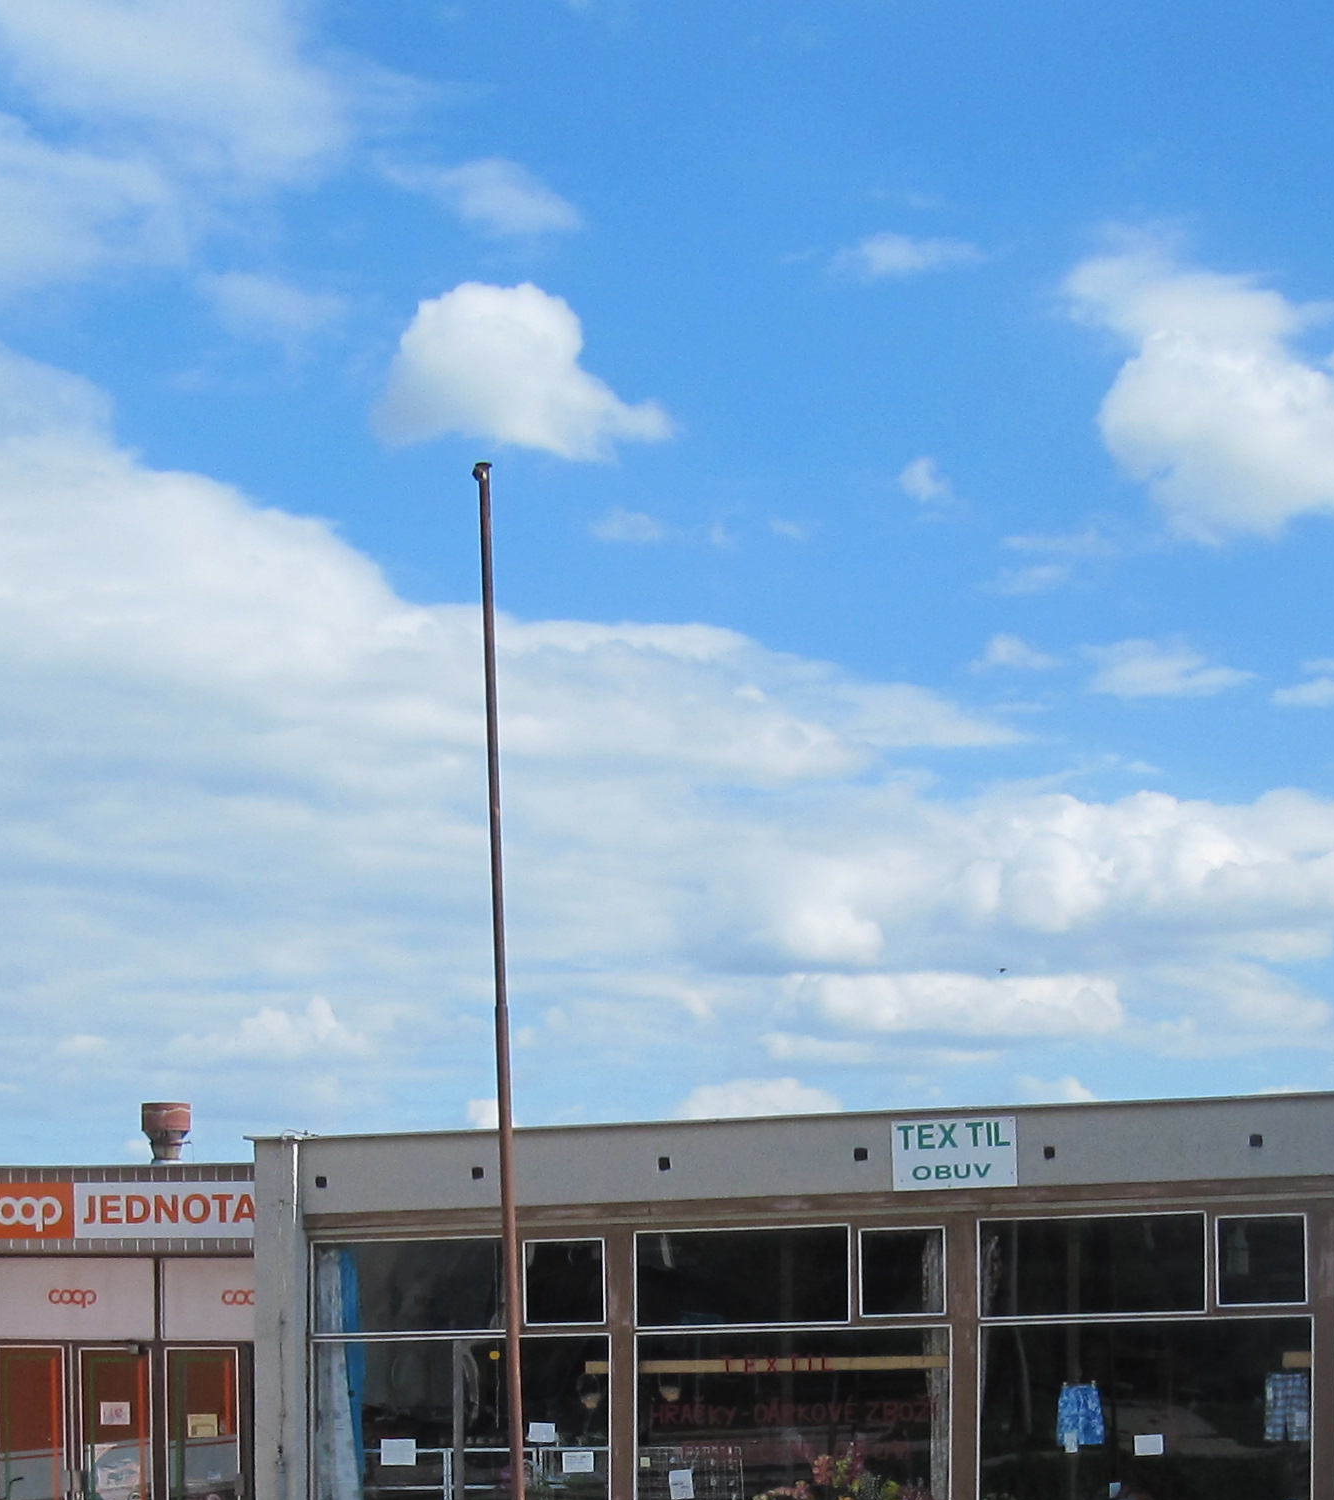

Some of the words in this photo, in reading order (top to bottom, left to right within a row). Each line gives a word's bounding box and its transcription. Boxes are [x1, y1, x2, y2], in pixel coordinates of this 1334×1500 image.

[912, 1163, 992, 1180] OBUV
[83, 1193, 255, 1224] JEDNOTA
[48, 1288, 97, 1308] coop
[221, 1289, 255, 1306] coo
[721, 1356, 834, 1372] TEXTIL
[650, 1396, 736, 1425] HRAČKY
